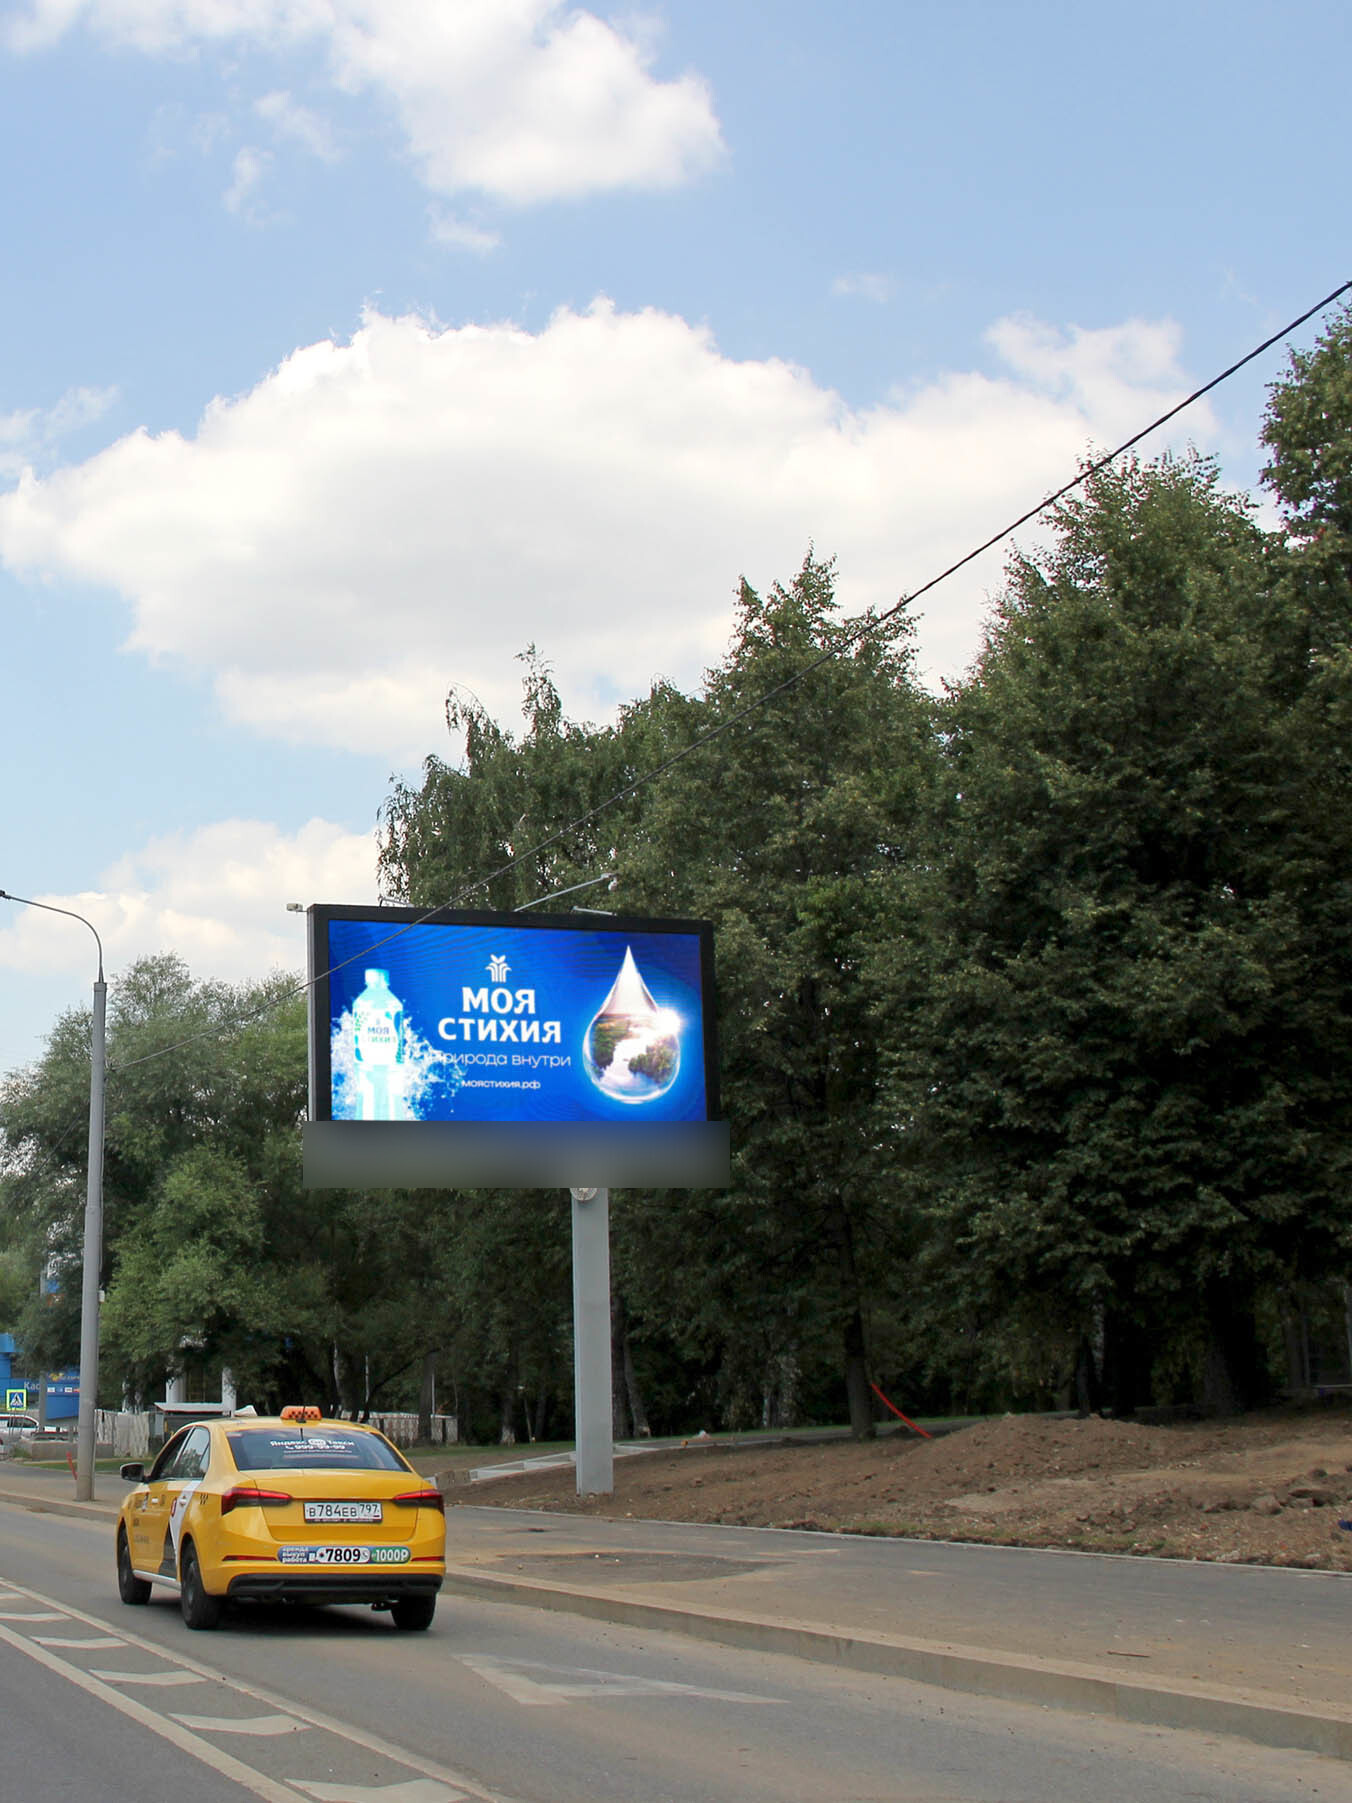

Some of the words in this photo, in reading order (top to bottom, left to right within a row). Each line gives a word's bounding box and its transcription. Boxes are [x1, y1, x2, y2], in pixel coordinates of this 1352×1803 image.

[462, 986, 536, 1014] МОЯ
[438, 1017, 561, 1044] СТИХИЯ
[512, 1054, 571, 1069] внутри
[461, 1080, 541, 1090] моястихия.рф
[360, 1504, 378, 1513] 797
